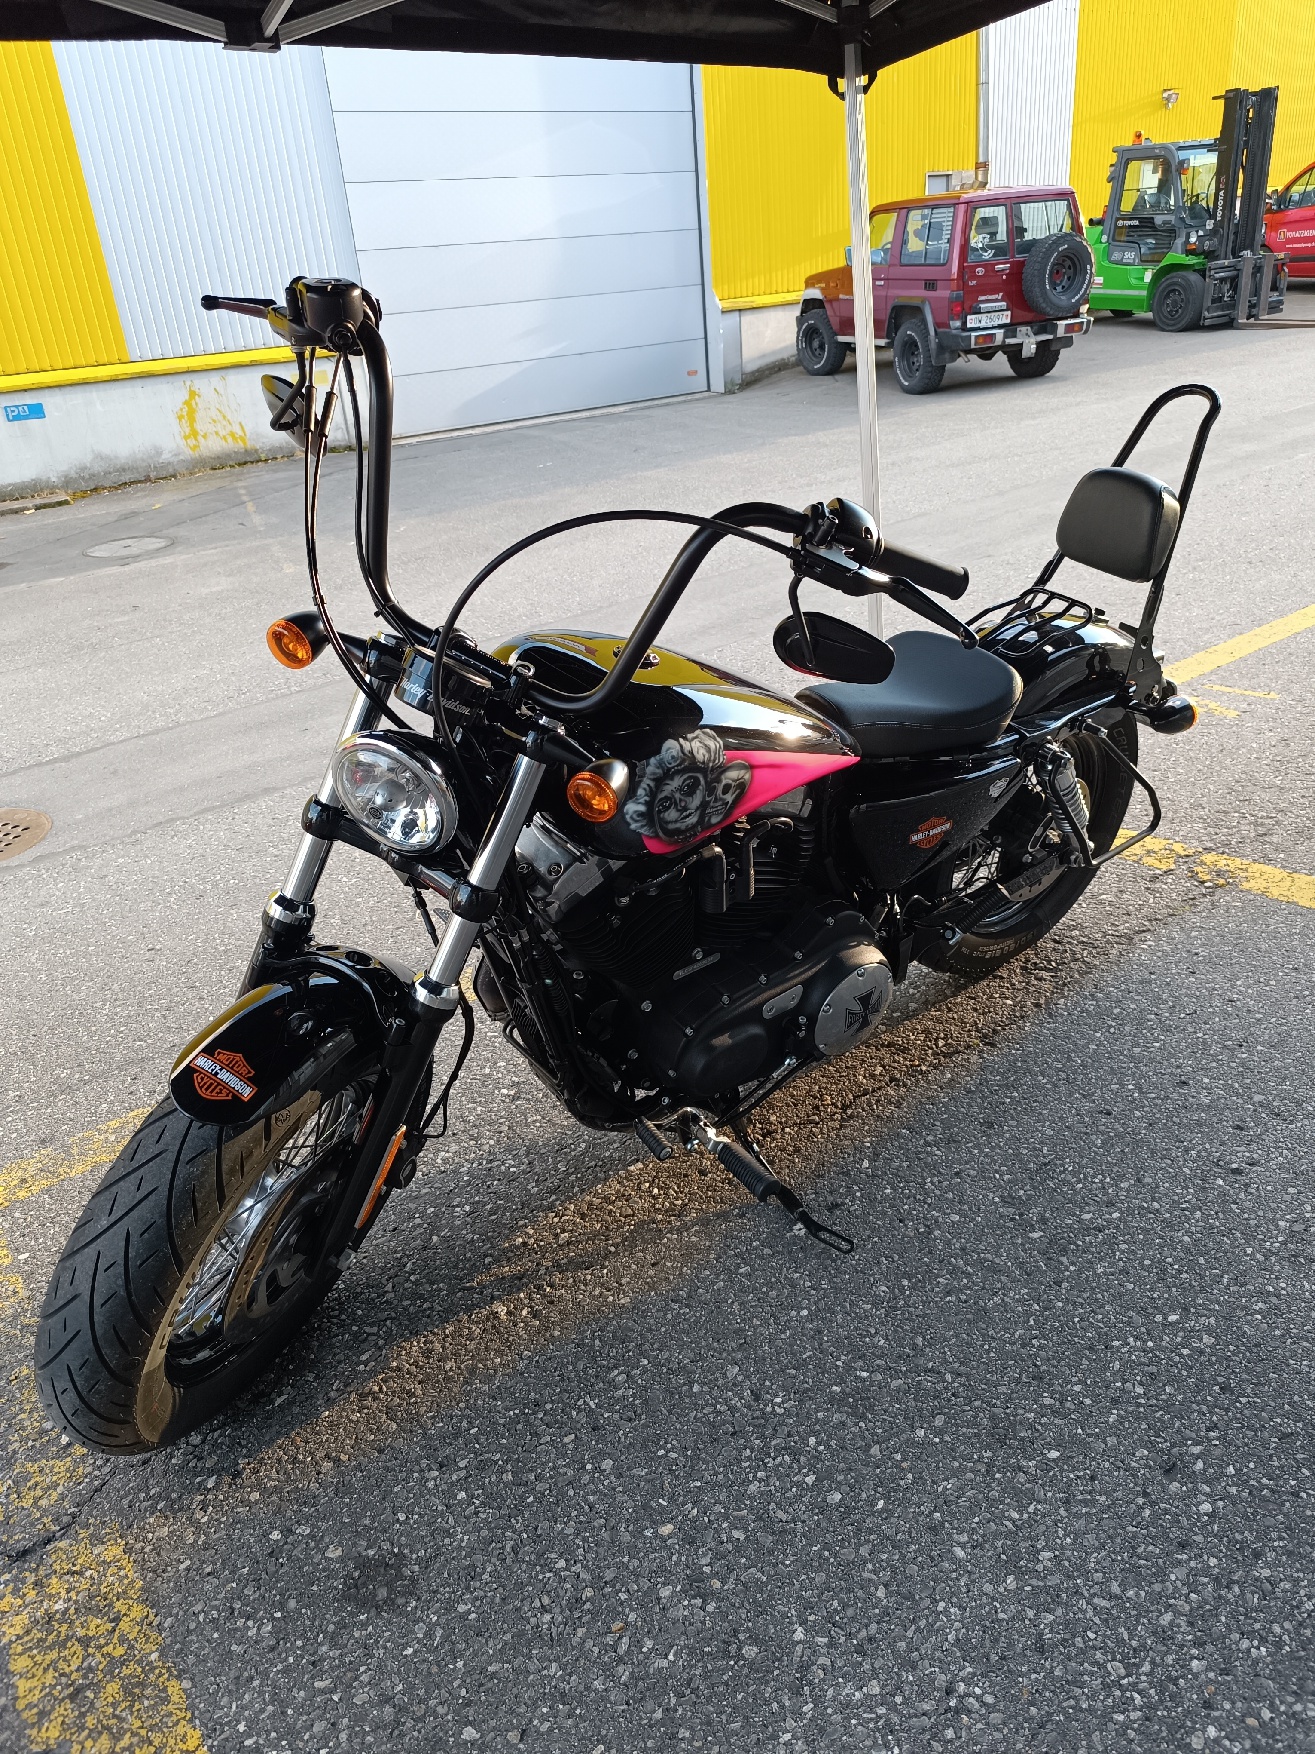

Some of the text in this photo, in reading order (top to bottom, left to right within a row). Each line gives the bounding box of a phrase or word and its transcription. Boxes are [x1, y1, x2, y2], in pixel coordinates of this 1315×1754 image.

[1216, 190, 1225, 221] TOYOTA
[985, 313, 1004, 324] 26097
[911, 822, 951, 842] HARLEY-DAVIDSON
[921, 818, 946, 830] MOTOR
[217, 1053, 250, 1076] MOTOR
[194, 1056, 253, 1097] HARLEY-DAVIDSON
[197, 1073, 229, 1097] CYCLES
